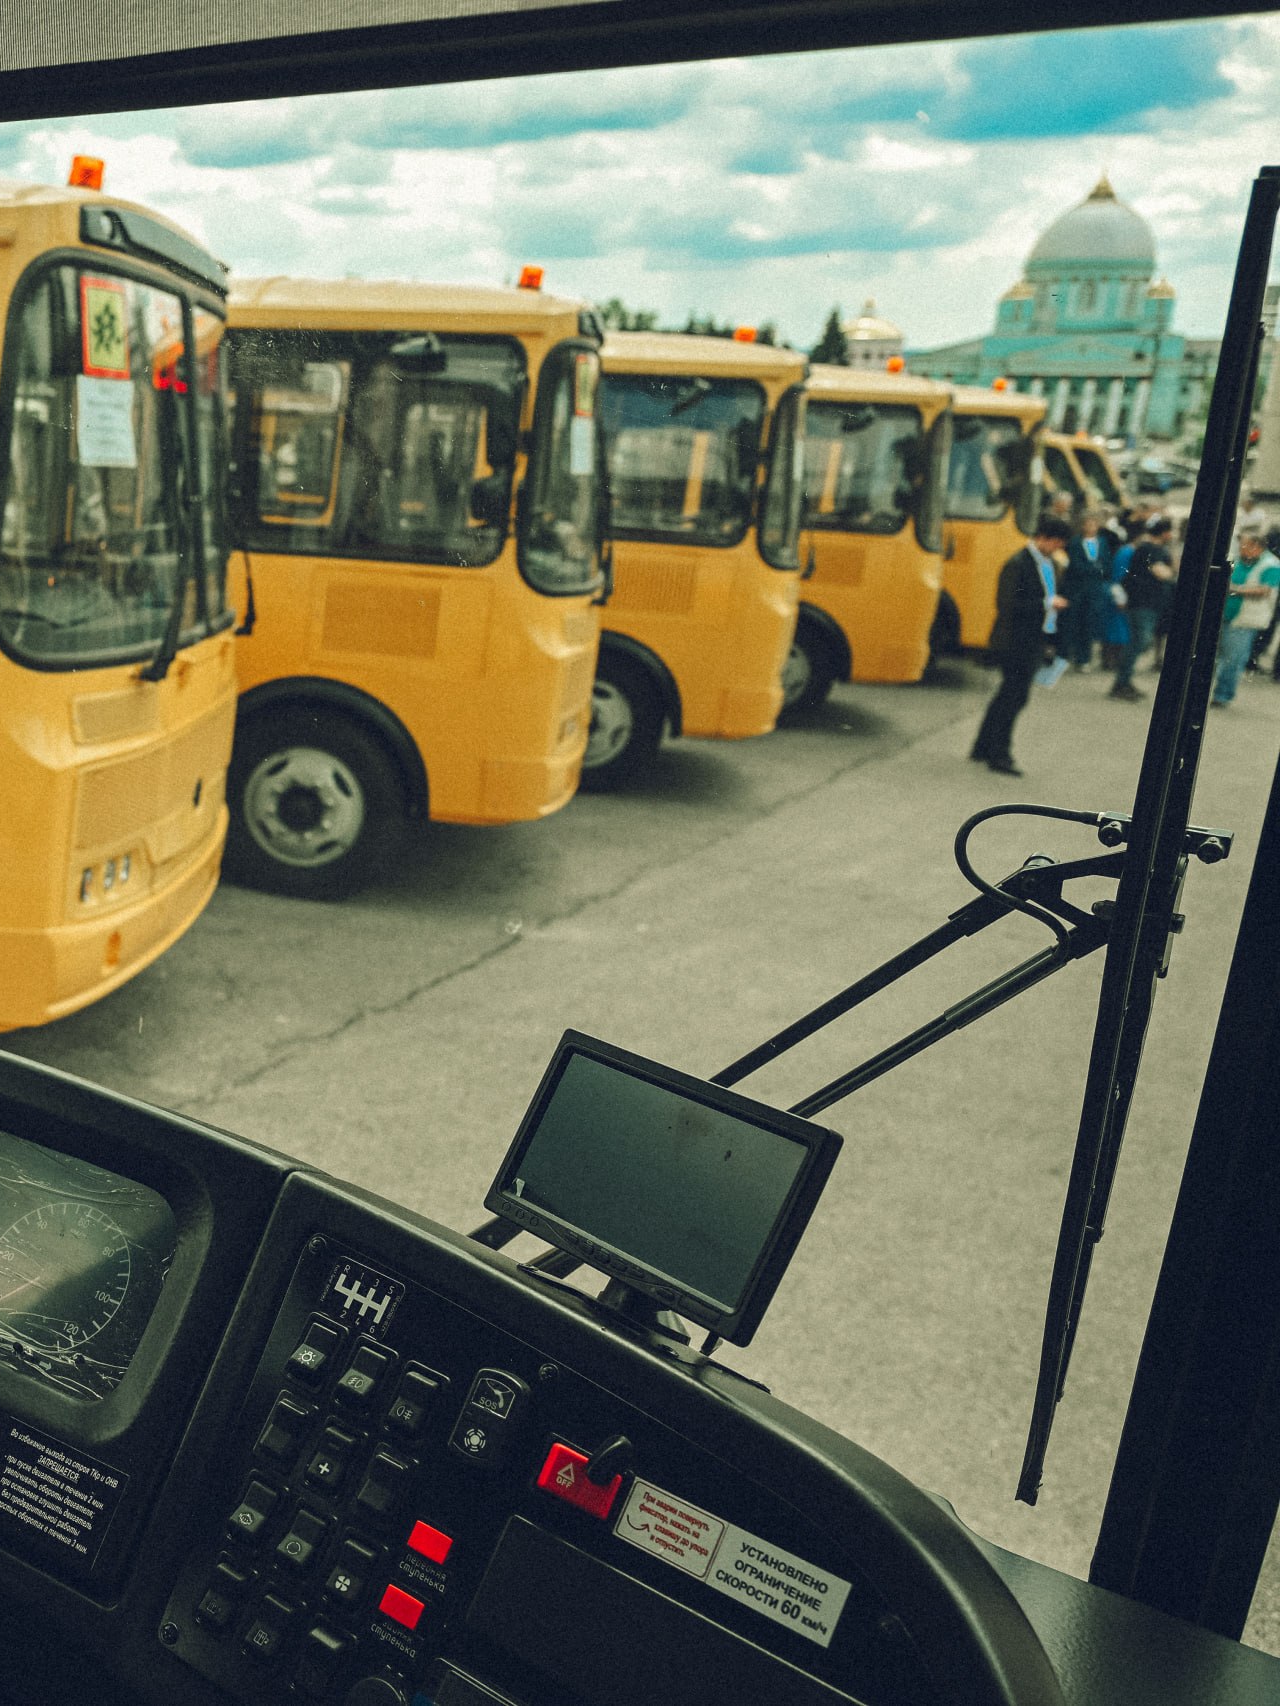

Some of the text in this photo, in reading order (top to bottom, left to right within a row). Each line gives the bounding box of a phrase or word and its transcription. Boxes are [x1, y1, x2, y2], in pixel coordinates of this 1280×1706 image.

[1, 1251, 14, 1261] 20
[102, 1246, 114, 1257] 80
[344, 1264, 351, 1274] R
[373, 1279, 380, 1287] 3
[387, 1285, 395, 1295] 5
[95, 1290, 111, 1303] 100
[63, 1322, 79, 1335] 120
[340, 1310, 347, 1318] 2
[355, 1317, 360, 1326] 4
[479, 1396, 498, 1410] SOS
[10, 1428, 19, 1438] Во
[45, 1447, 66, 1462] выхода
[105, 1476, 119, 1488] ОНВ
[6, 1455, 18, 1464] при
[31, 1466, 61, 1487] двигателя
[64, 1485, 88, 1501] течение
[87, 1495, 93, 1504] 2
[556, 1476, 572, 1488] OFF
[0, 1477, 11, 1486] при
[10, 1482, 39, 1501] остановке
[63, 1508, 92, 1530] двигатель
[38, 1484, 64, 1502] обороты
[643, 1491, 656, 1504] При
[1, 1488, 11, 1499] без
[56, 1520, 80, 1536] работы
[17, 1511, 44, 1530] оборотах
[71, 1539, 77, 1547] 3
[692, 1531, 700, 1539] на
[679, 1537, 690, 1547] до
[689, 1542, 709, 1557] упора
[399, 1561, 445, 1593] ступенька
[740, 1541, 829, 1595] УСТАНОВЛЕНО
[734, 1559, 823, 1612] ОГРАНИЧЕНИЕ
[715, 1569, 828, 1636] СКОРОСТИ 60 км/ч
[370, 1623, 416, 1658] ступенька
